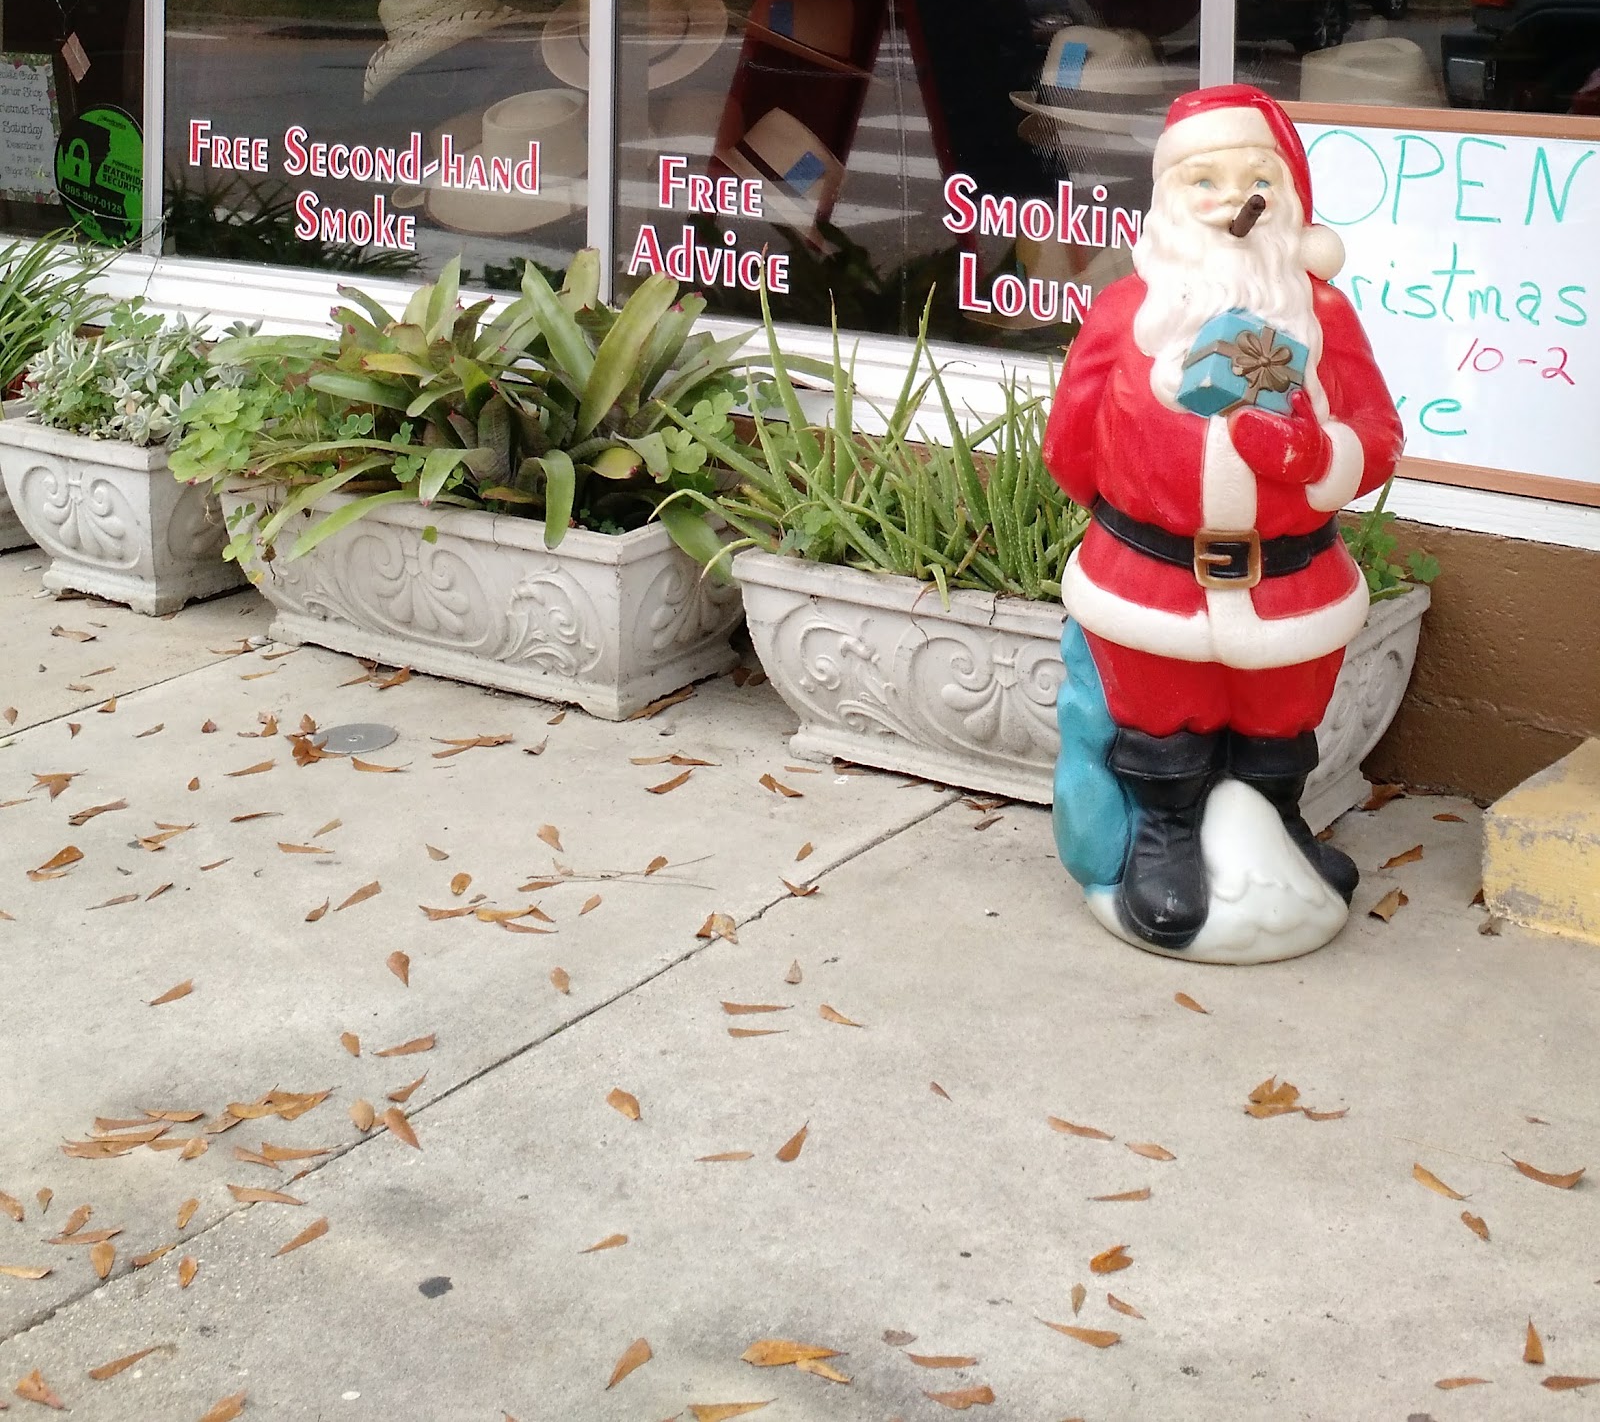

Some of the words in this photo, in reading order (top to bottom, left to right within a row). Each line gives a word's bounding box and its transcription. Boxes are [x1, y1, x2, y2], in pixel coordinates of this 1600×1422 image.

[1307, 129, 1596, 226] OPEN
[1330, 242, 1587, 326] ristmas
[1457, 338, 1575, 385] 10-2
